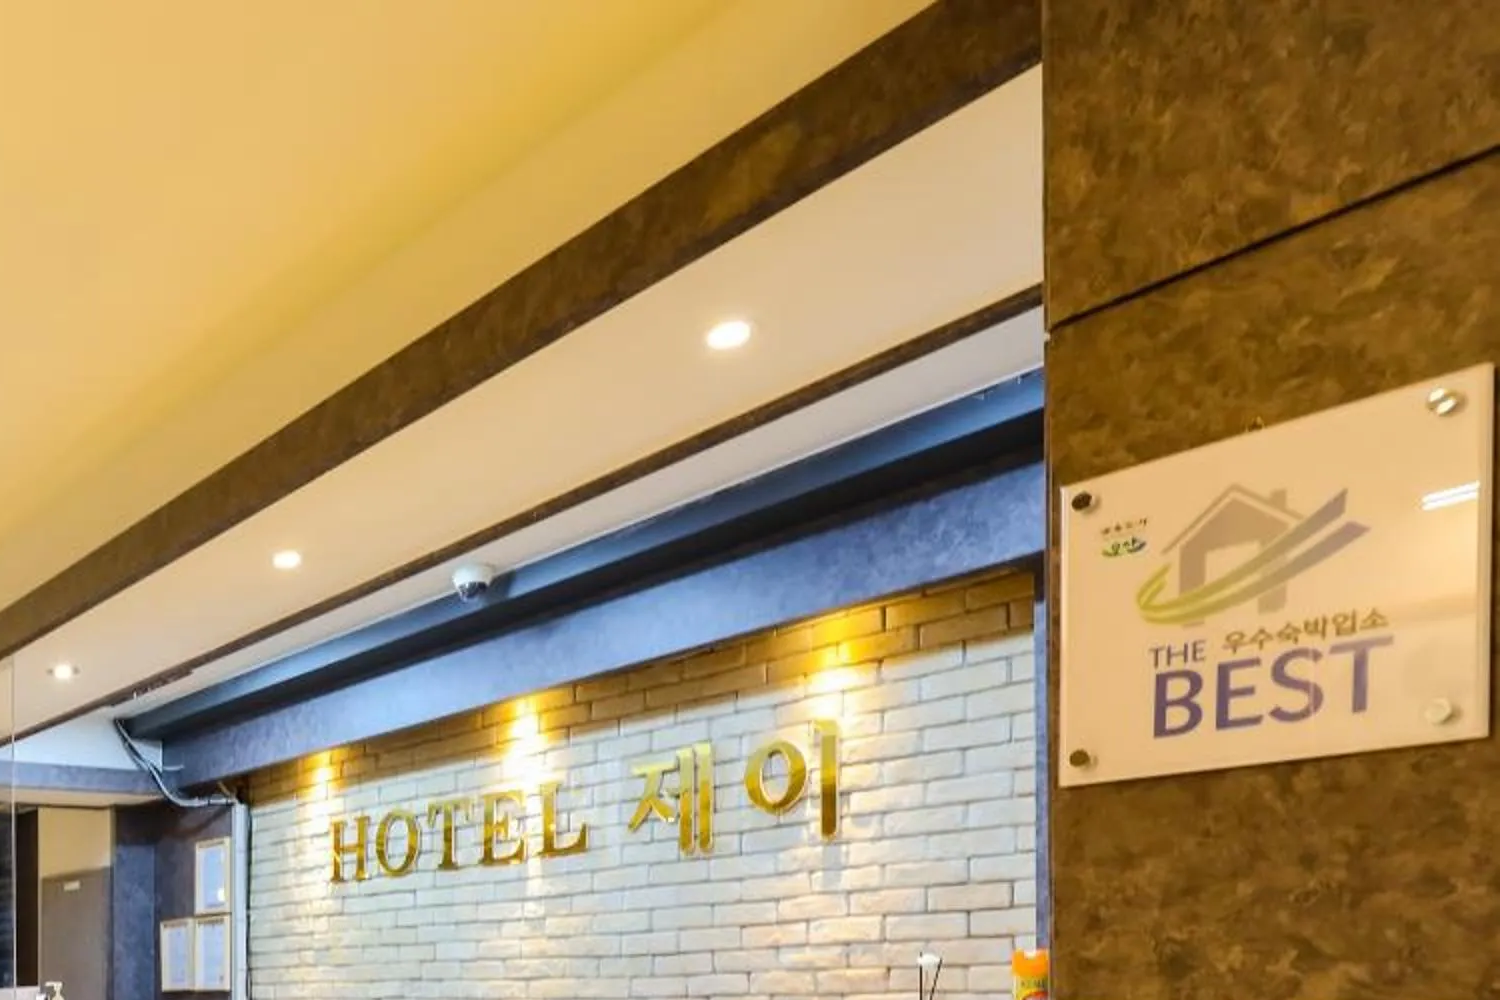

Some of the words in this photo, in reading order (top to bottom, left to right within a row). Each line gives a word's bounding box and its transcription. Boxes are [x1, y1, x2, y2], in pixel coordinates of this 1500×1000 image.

[1150, 639, 1207, 669] THE
[1222, 608, 1388, 654] 우수숙박업소
[1153, 635, 1394, 739] BEST
[329, 782, 589, 883] HOTEL
[627, 719, 843, 856] 제이
